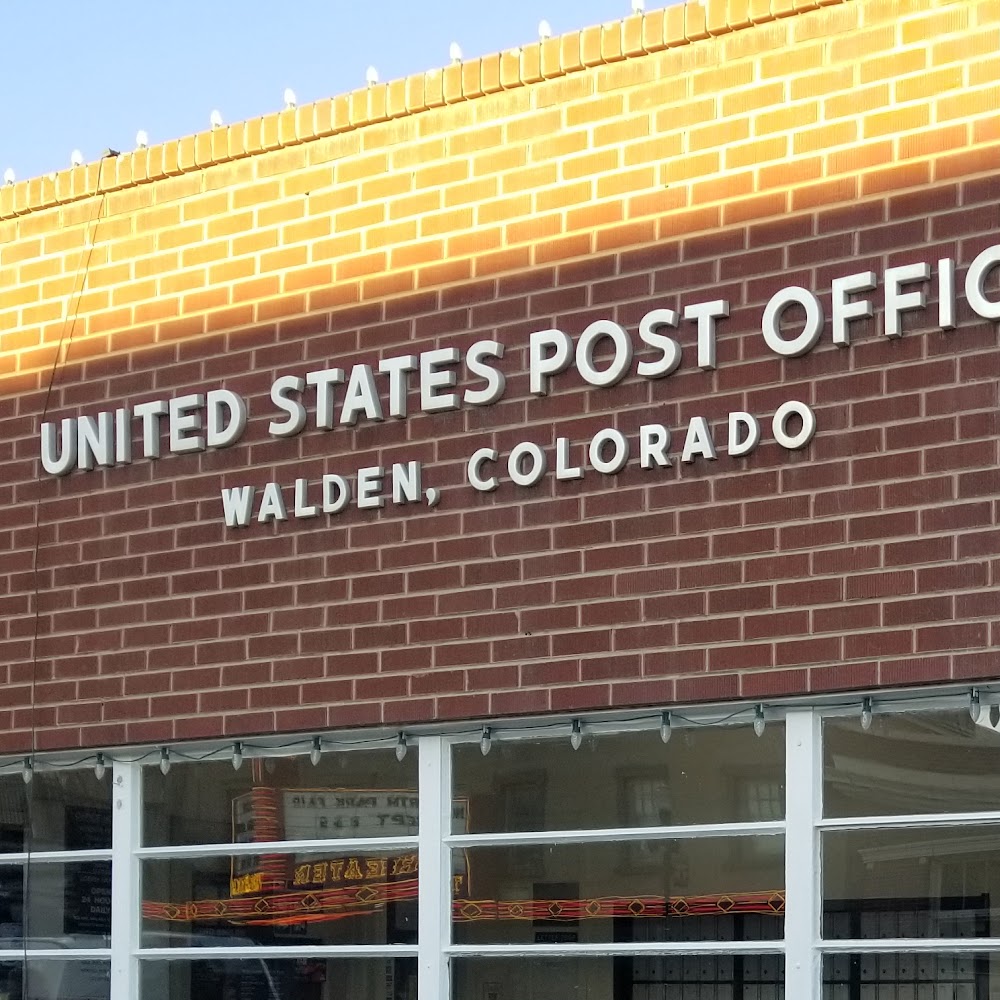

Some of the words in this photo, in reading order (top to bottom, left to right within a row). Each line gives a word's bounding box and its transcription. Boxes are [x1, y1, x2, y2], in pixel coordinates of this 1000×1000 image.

[40, 389, 247, 476] UNITED
[268, 340, 506, 438] STATES
[529, 299, 730, 397] POST
[221, 460, 442, 528] WALDEN,
[467, 400, 817, 492] COLORADO
